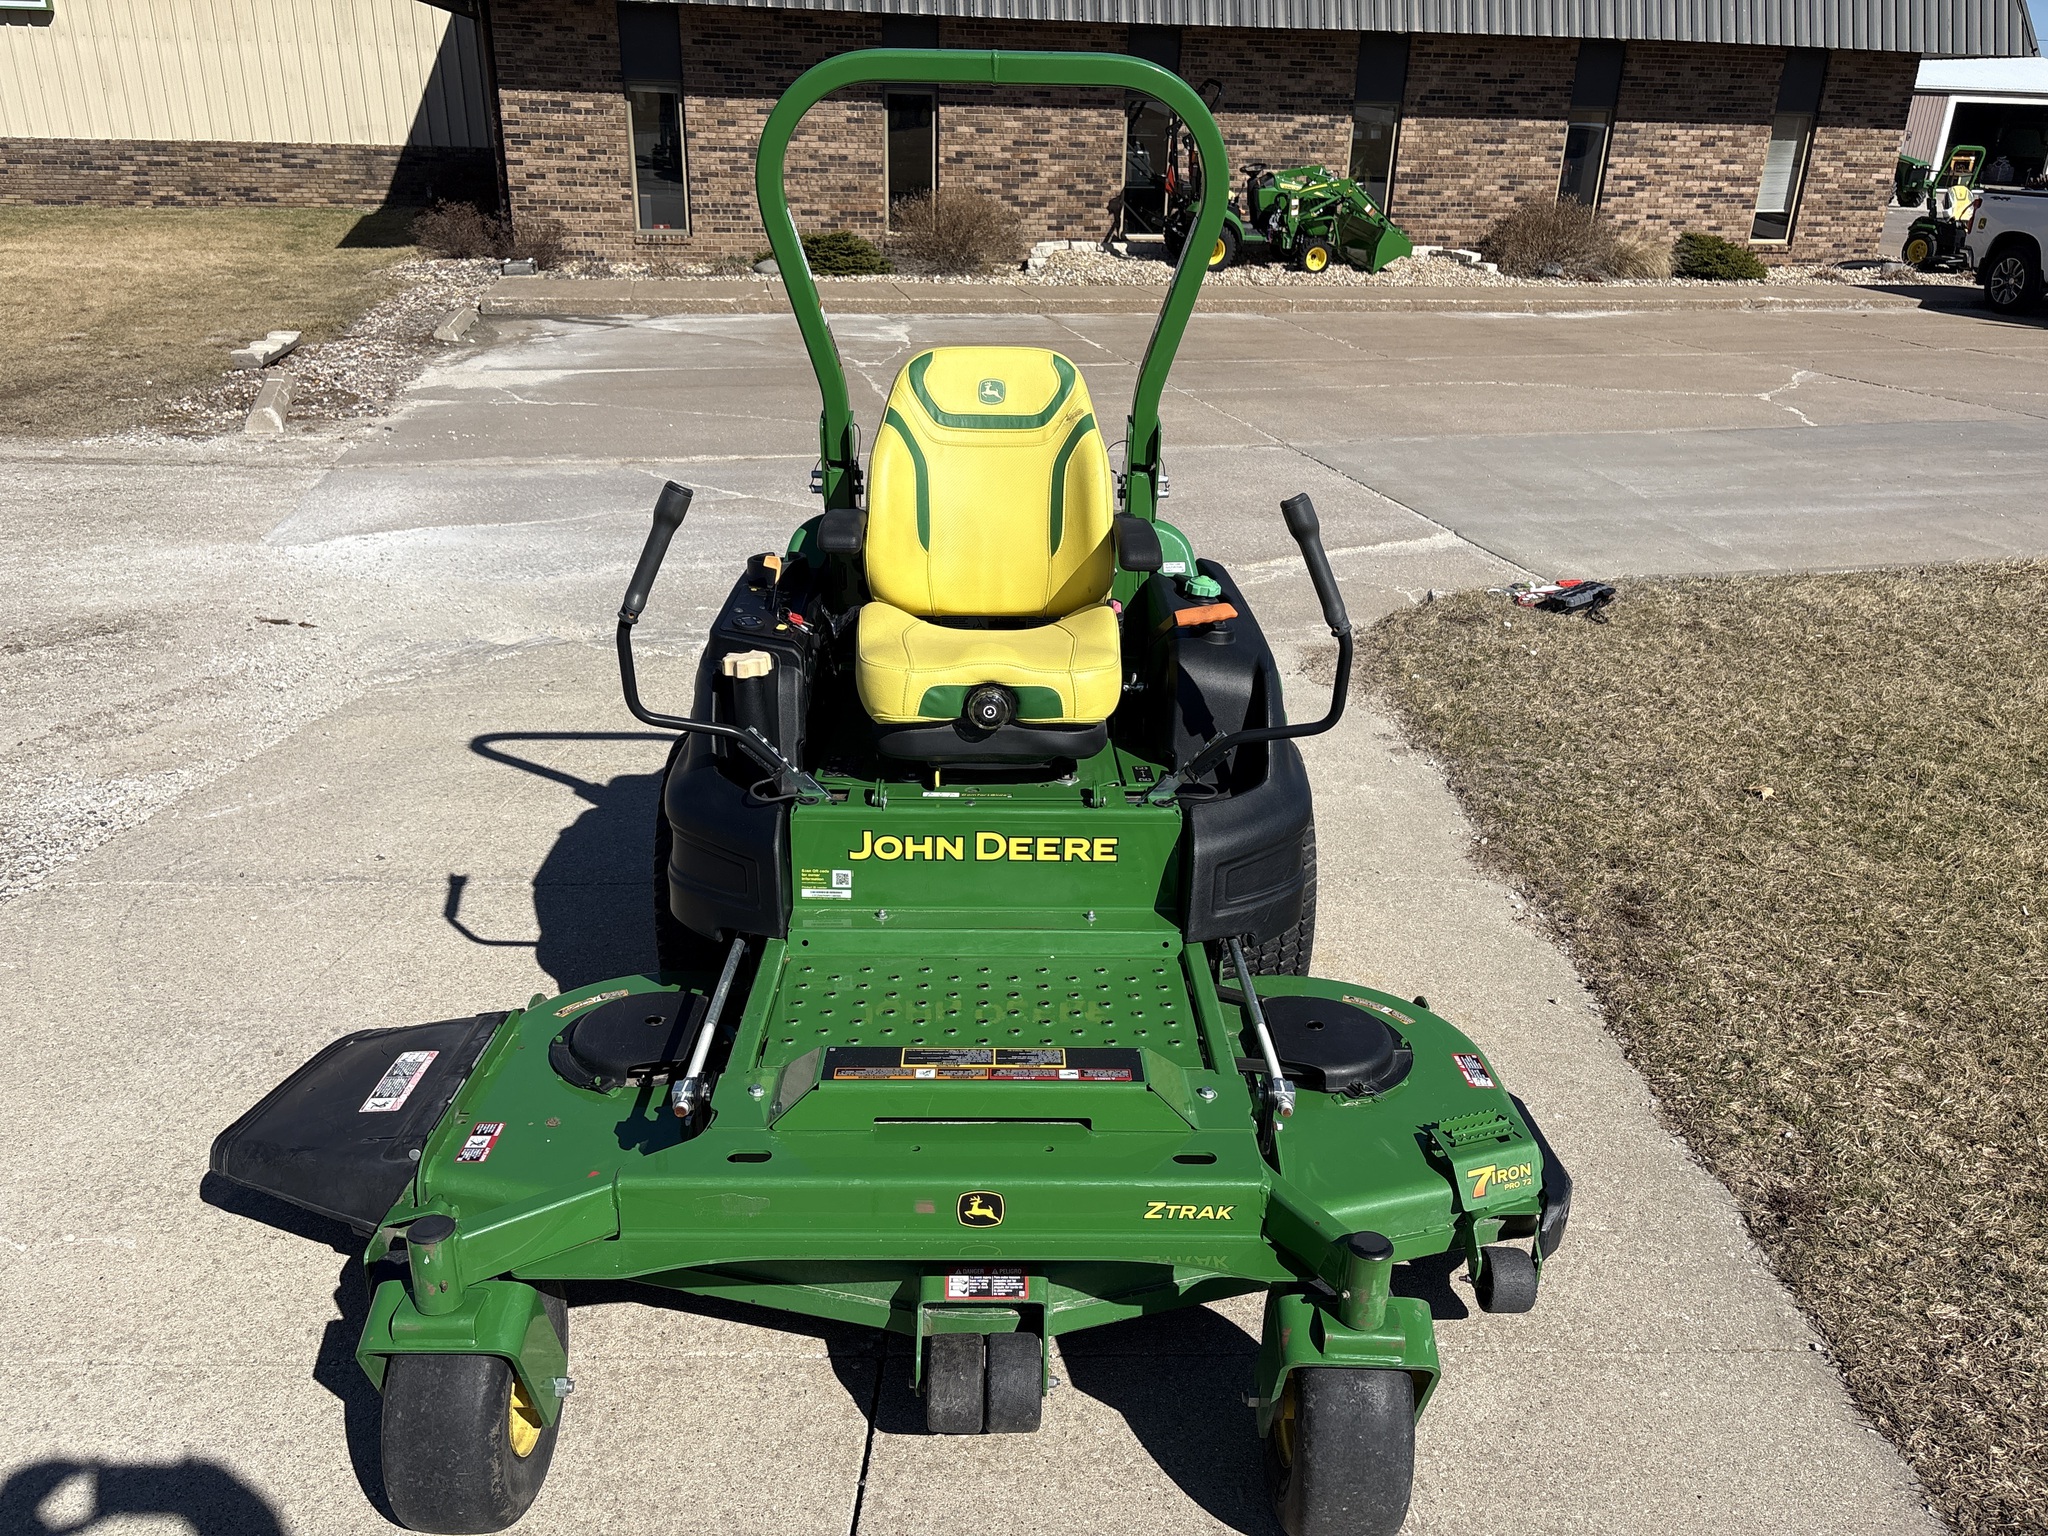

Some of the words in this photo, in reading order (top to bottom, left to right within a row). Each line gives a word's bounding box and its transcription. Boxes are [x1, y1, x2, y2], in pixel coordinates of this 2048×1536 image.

[849, 830, 965, 861] JOHN
[975, 830, 1119, 862] DEERE
[1504, 1181, 1520, 1191] PRO
[1143, 1201, 1237, 1220] ZTRAK
